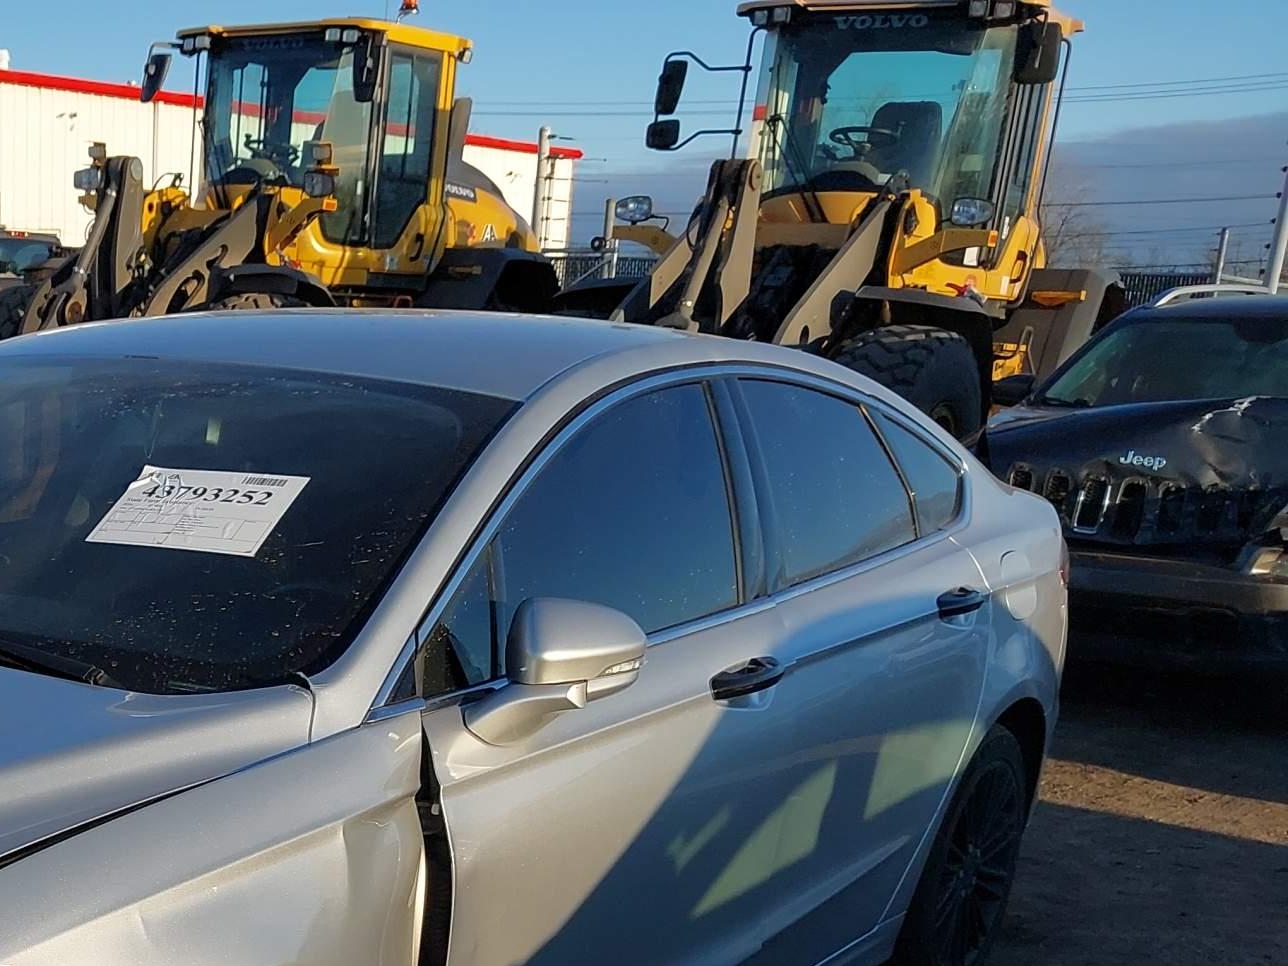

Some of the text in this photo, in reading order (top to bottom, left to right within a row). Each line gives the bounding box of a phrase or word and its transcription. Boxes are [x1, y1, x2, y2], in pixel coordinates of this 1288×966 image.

[834, 14, 928, 30] VOLVO
[1120, 450, 1167, 471] Jeep
[142, 484, 273, 506] 43793252
